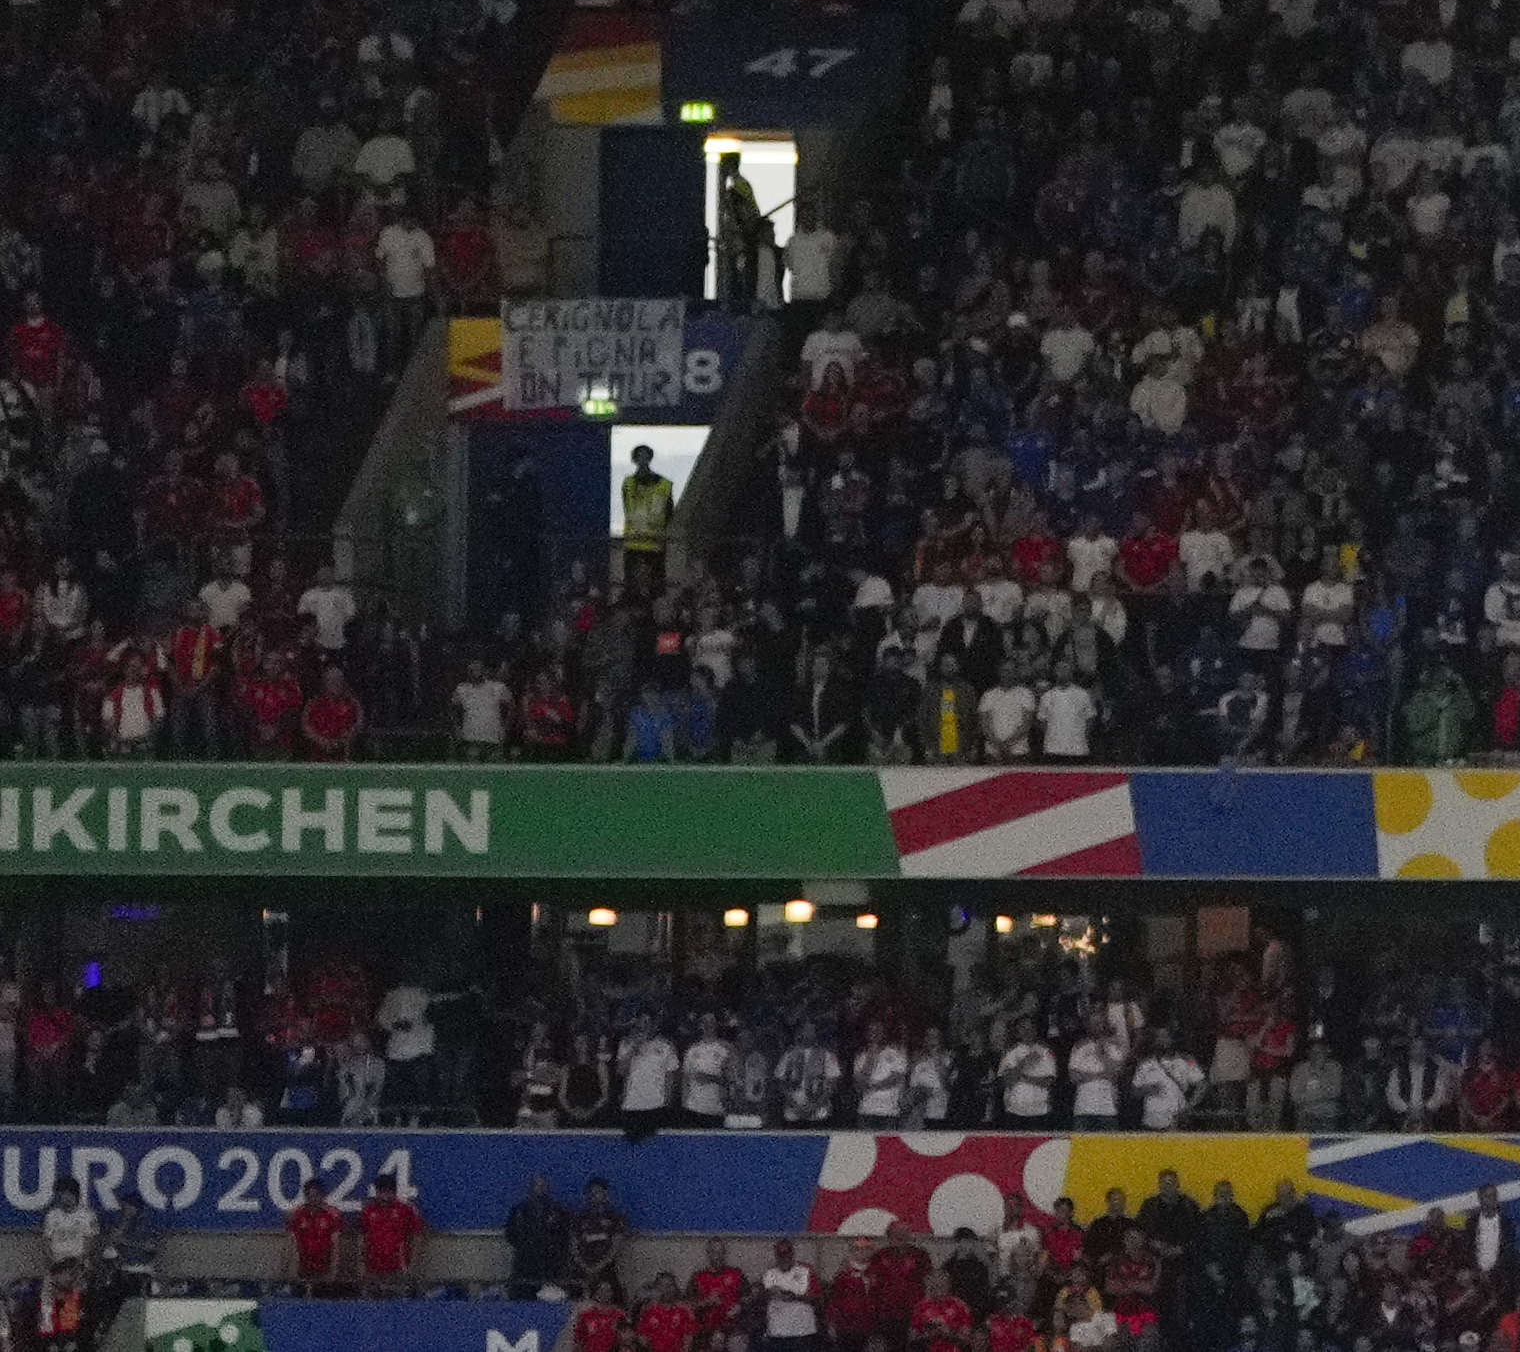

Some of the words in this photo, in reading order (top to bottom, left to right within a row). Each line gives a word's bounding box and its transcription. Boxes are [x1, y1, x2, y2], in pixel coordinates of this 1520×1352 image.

[747, 49, 856, 77] 47
[684, 351, 722, 393] 8
[0, 786, 490, 856] KIRCHEN
